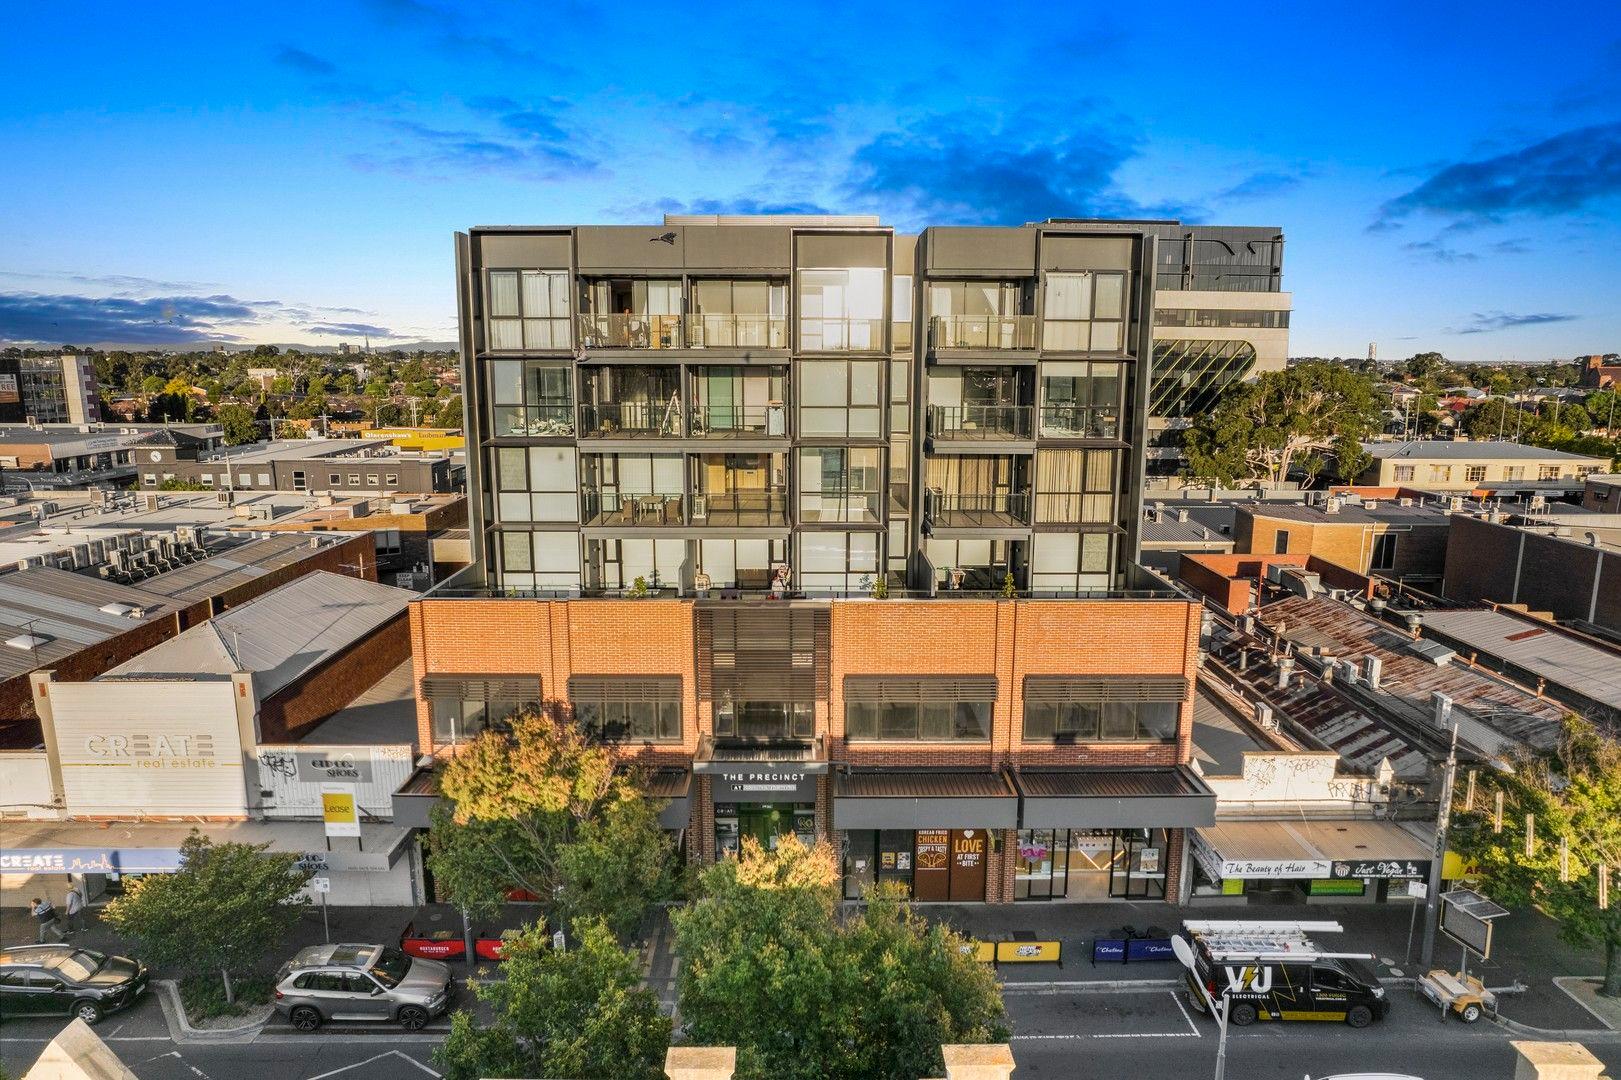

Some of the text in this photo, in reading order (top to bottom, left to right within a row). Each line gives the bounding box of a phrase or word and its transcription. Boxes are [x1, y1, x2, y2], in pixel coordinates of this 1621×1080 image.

[1, 383, 16, 391] REE
[85, 734, 215, 758] CREATE
[137, 757, 216, 769] real estate
[723, 773, 805, 781] THE PRECINCT
[325, 804, 351, 813] Lease
[918, 835, 947, 844] CHICKEN
[955, 839, 983, 853] LOVE
[0, 855, 64, 868] CREATE
[298, 862, 329, 871] SHOES
[1225, 863, 1306, 875] The Beauty of Hair
[1355, 863, 1375, 874] Just
